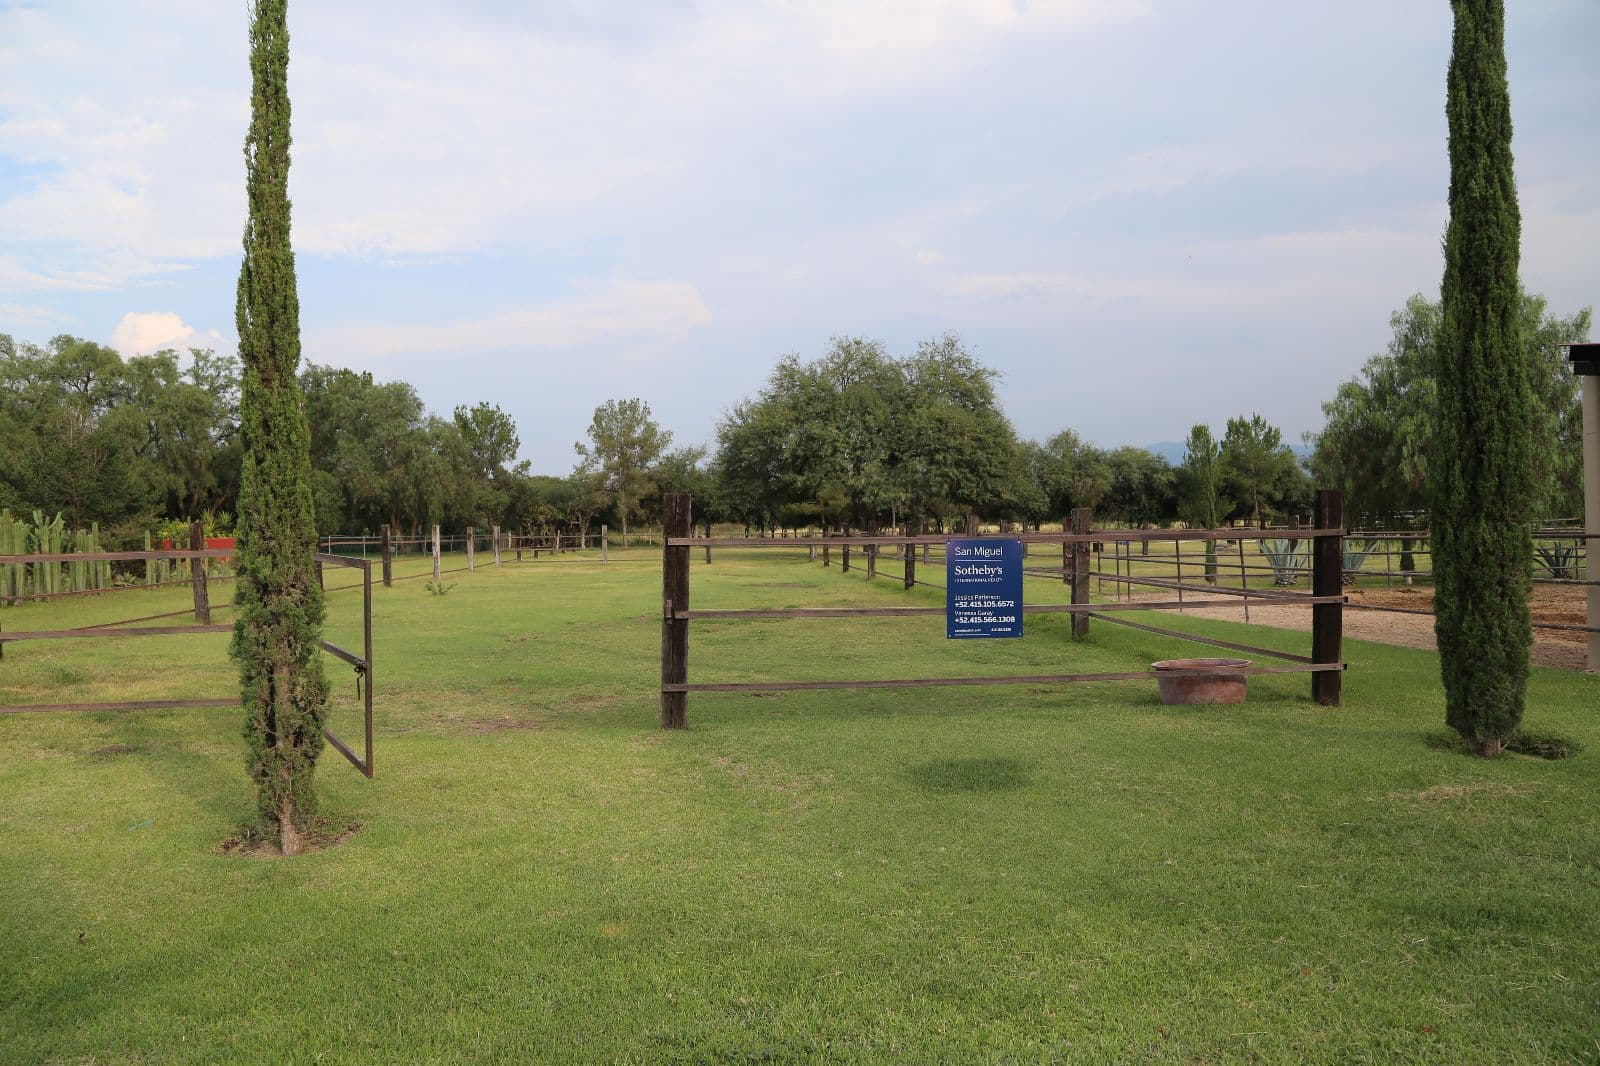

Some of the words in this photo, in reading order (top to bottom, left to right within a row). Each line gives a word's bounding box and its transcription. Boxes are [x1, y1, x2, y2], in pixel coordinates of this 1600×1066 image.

[955, 546, 971, 556] San
[974, 546, 1003, 558] Miguel
[954, 565, 1003, 577] Sotheby's
[954, 600, 1015, 608] +52.415.105.6572
[954, 616, 1016, 624] +52.415.566.1308
